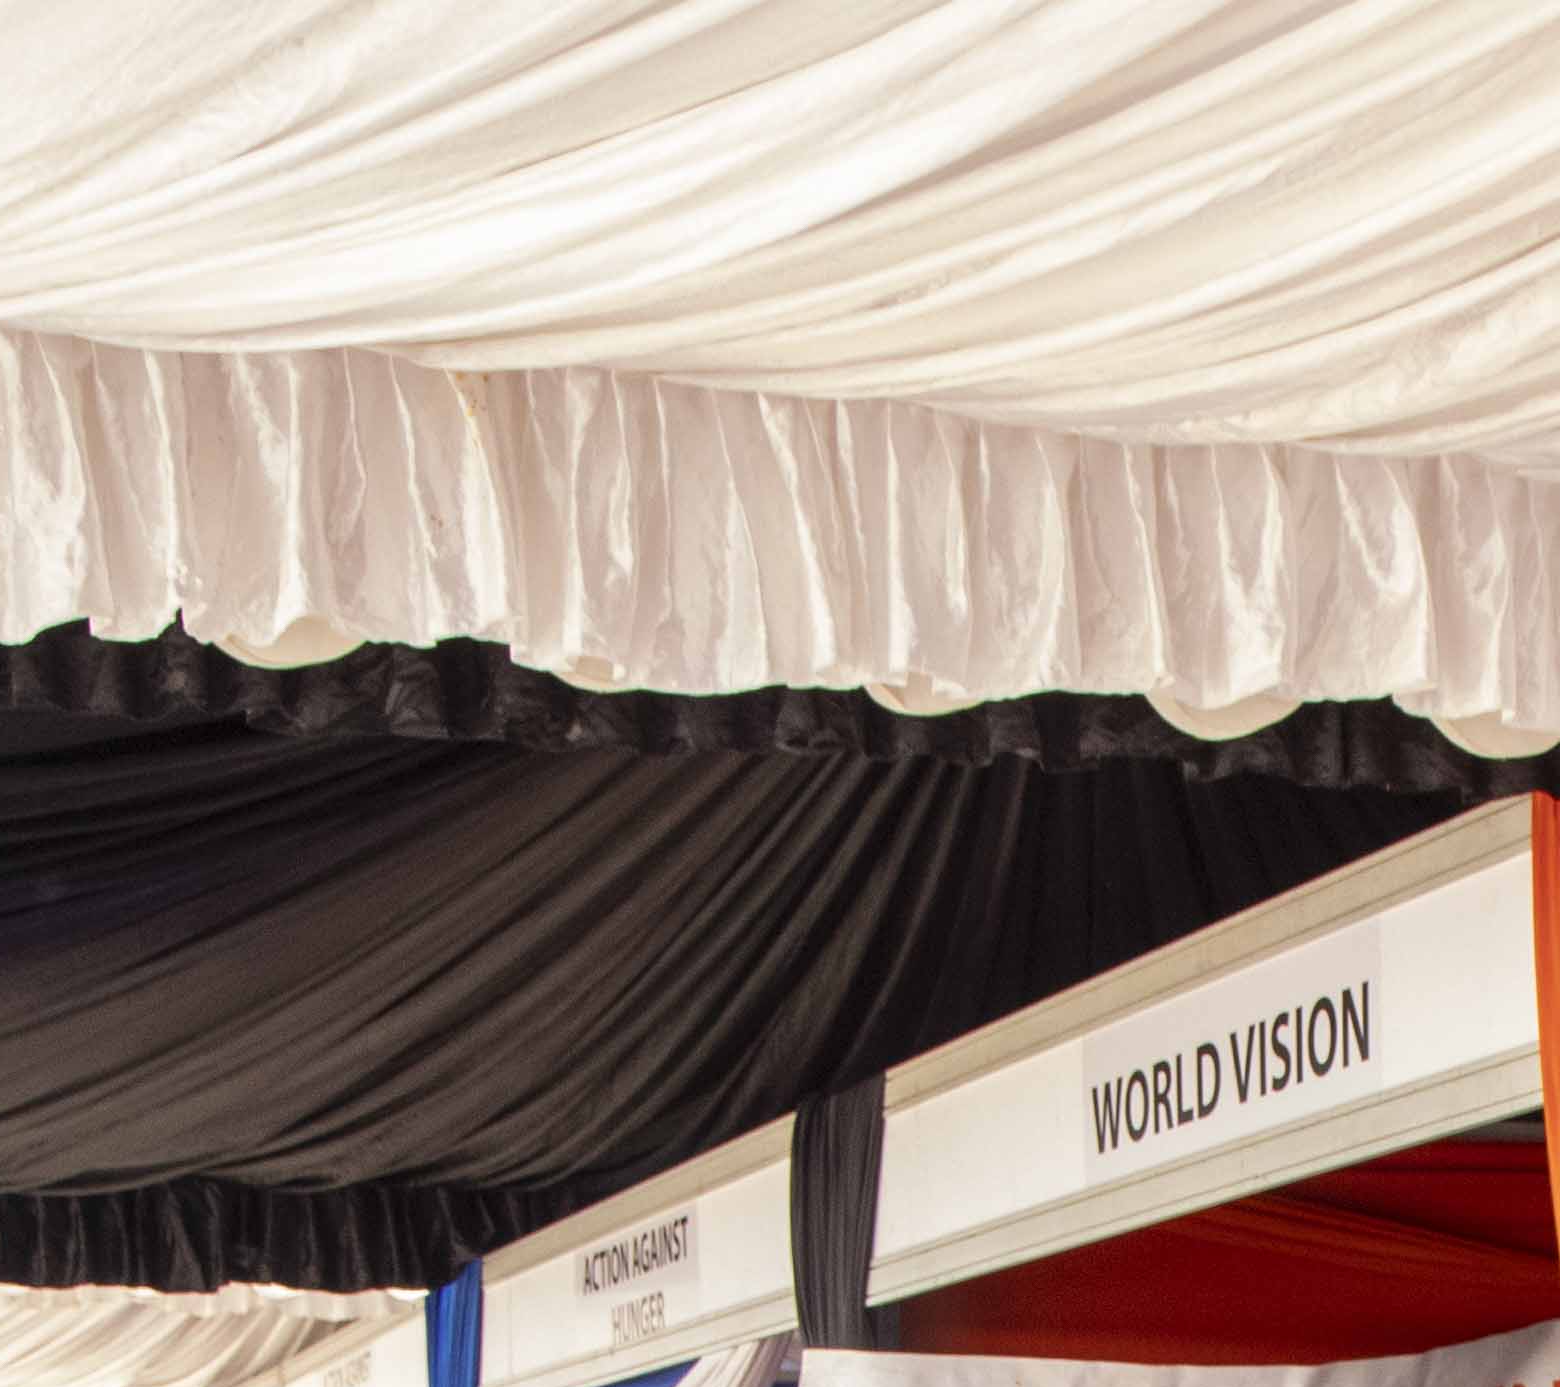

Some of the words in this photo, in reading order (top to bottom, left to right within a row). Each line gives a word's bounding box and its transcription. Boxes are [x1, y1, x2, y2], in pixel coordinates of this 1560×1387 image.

[1091, 1042, 1221, 1154] WORLD
[1230, 981, 1371, 1104] VISION
[583, 1247, 629, 1295] ACTION
[631, 1216, 689, 1274] AGAINST
[611, 1291, 665, 1345] HUNGER
